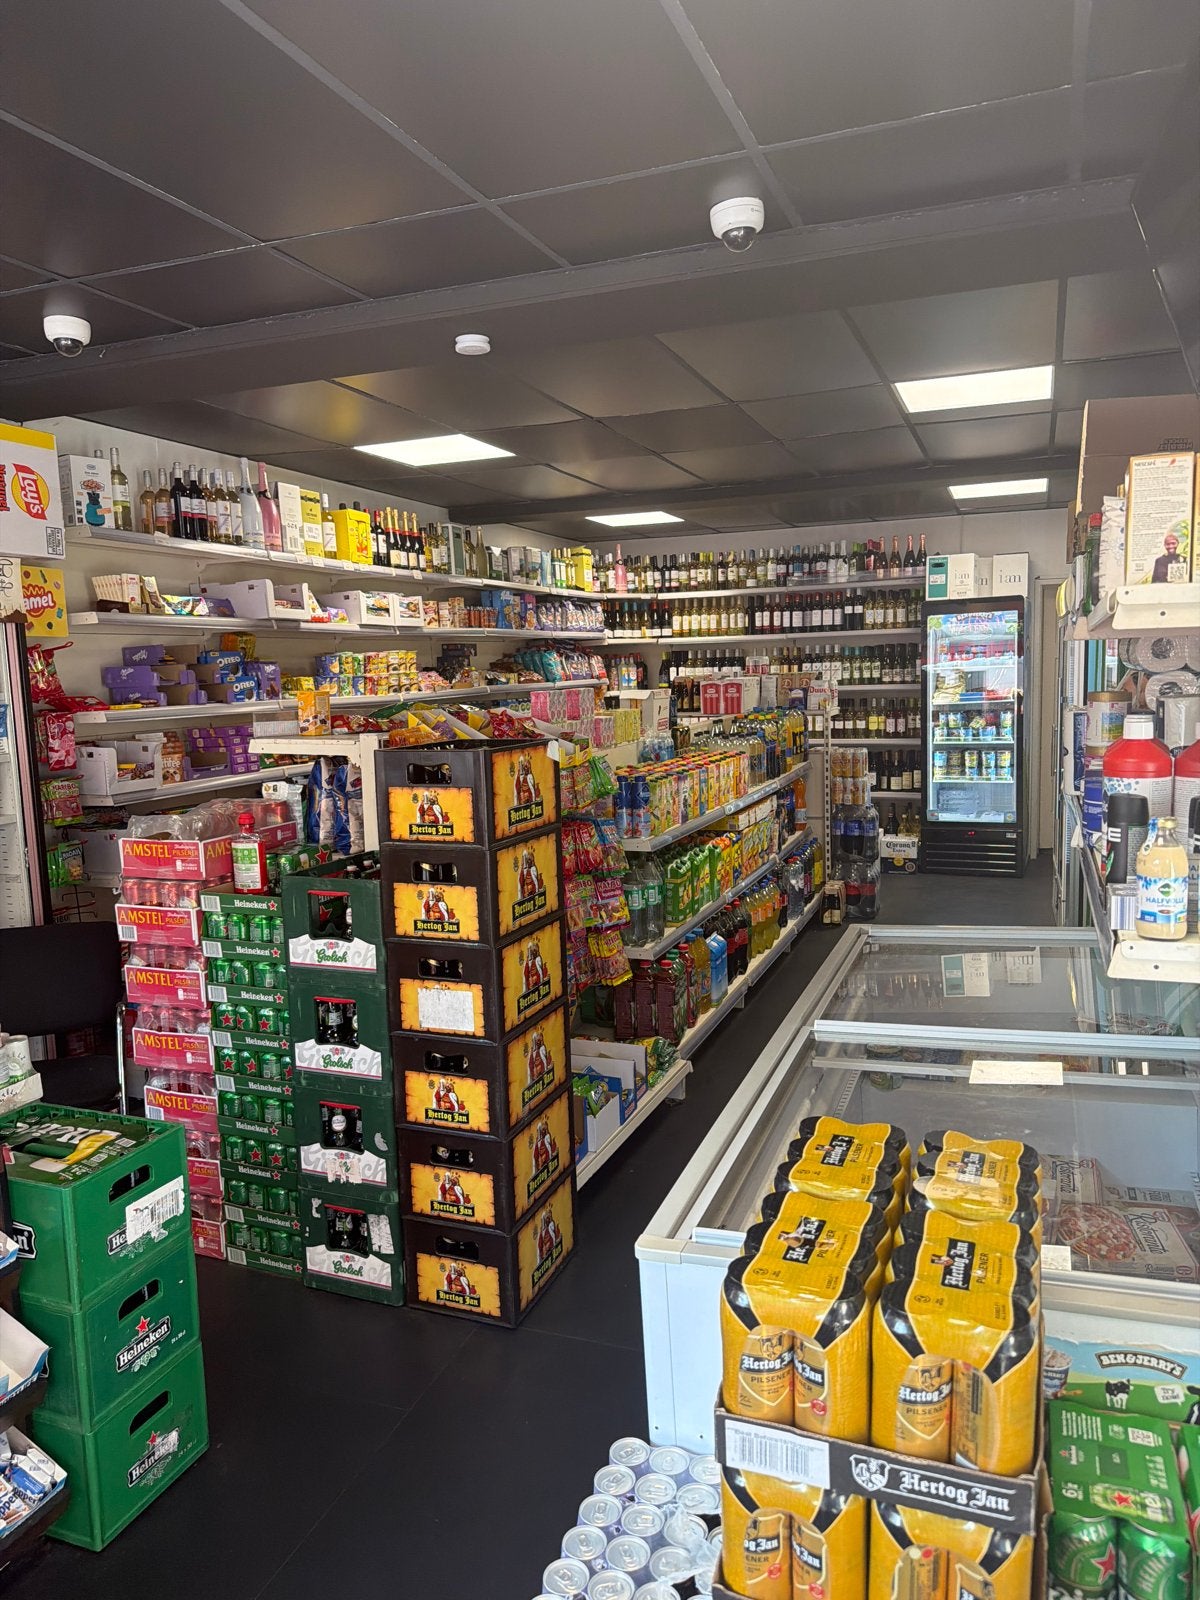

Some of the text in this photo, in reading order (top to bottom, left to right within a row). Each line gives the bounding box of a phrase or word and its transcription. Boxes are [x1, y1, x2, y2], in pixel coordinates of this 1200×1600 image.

[18, 471, 44, 514] Lay's
[24, 592, 54, 611] amel
[217, 655, 241, 668] OREO
[233, 680, 255, 692] OREO
[411, 825, 453, 836] Hertog Jan
[124, 843, 172, 858] AMSTEL
[234, 899, 267, 909] Heineken
[120, 910, 165, 925] AMSTEL
[416, 921, 458, 933] Hertog Jan
[236, 946, 270, 956] Heineken
[316, 949, 347, 963] Grolsch
[128, 971, 173, 986] AMSTEL
[240, 991, 273, 1001] Heineken
[136, 1036, 182, 1050] AMSTEL
[245, 1037, 279, 1047] Heineken
[322, 1054, 353, 1070] Grolsch
[248, 1082, 282, 1093] Heineken
[147, 1092, 190, 1110] AMSTEL
[427, 1110, 468, 1123] Hertog Jan
[236, 1122, 269, 1133] Heineken
[238, 1166, 271, 1177] Heineken
[433, 1202, 474, 1216] Hertog Jan
[257, 1214, 291, 1227] Heineken
[260, 1257, 293, 1271] Heineken
[332, 1260, 363, 1277] Grolsch
[439, 1291, 479, 1306] Hertog Jan
[119, 1323, 168, 1368] Heineken
[742, 1356, 781, 1370] Hertog
[802, 1363, 822, 1383] Jan
[898, 1385, 939, 1402] Hertog
[900, 1472, 1011, 1512] Hertog Jan
[757, 1538, 779, 1552] Jan
[801, 1547, 821, 1569] Jan
